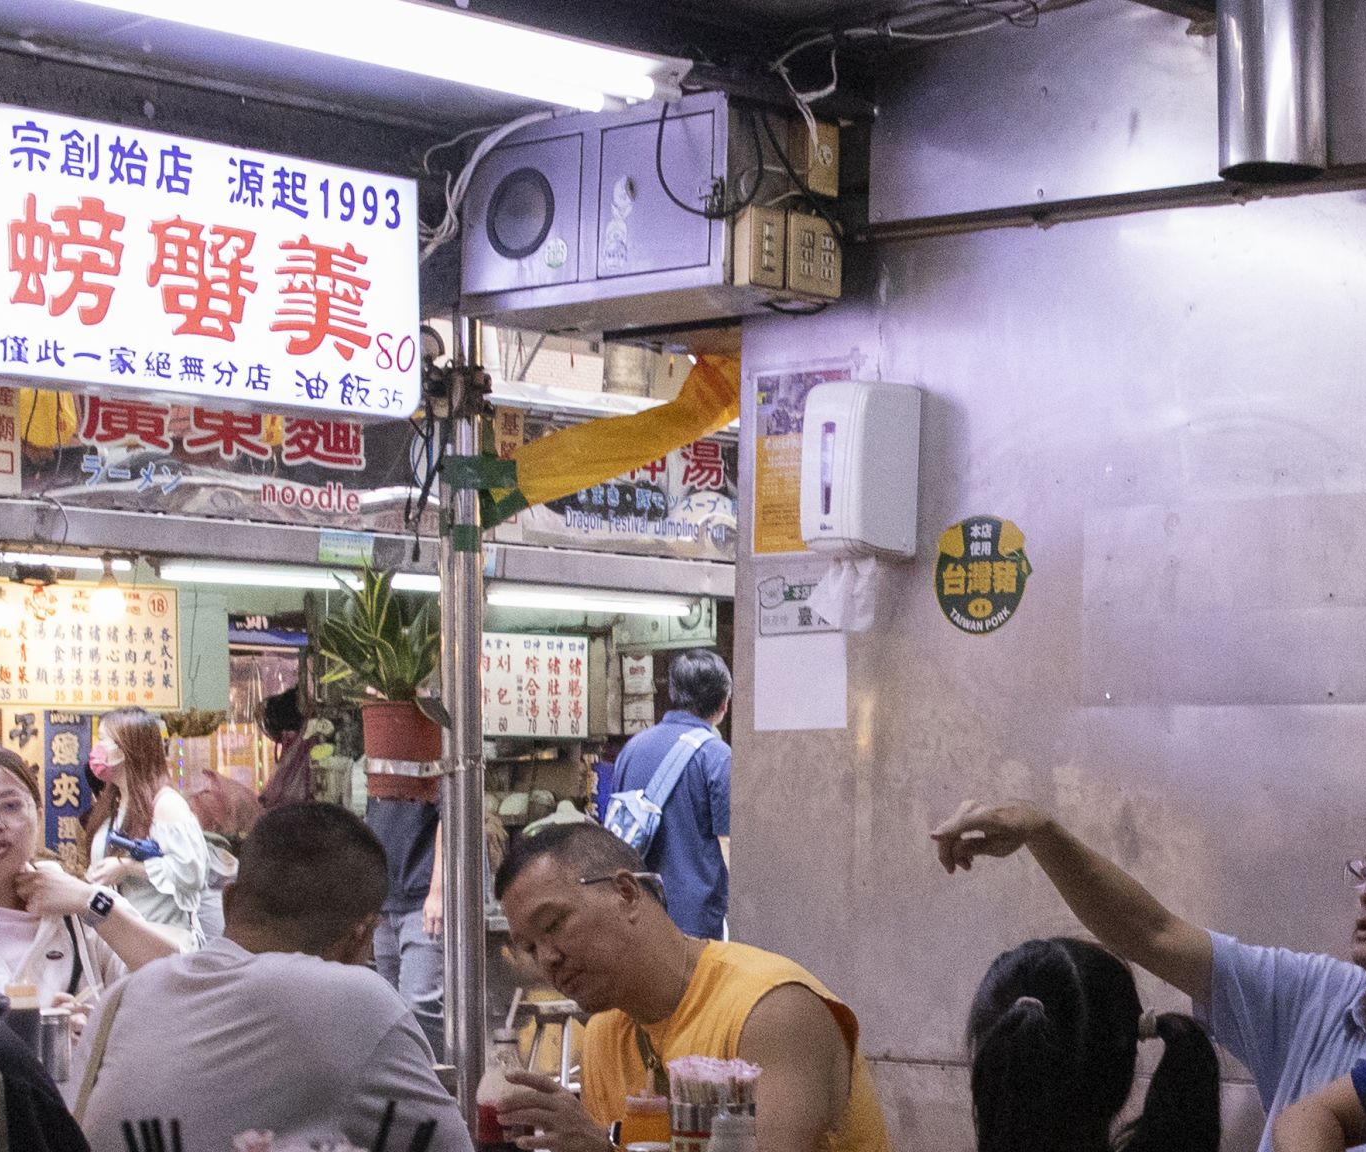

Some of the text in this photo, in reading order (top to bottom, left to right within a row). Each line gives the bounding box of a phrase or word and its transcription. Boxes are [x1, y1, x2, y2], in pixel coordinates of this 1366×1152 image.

[7, 193, 417, 374] 螃蟹羹 80
[0, 335, 272, 392] 僅此一家絕無分店
[82, 454, 184, 495] ラーメン
[261, 480, 361, 513] noodle
[565, 505, 603, 533] Dragon
[970, 523, 993, 539] 本店
[969, 541, 992, 556] 使用
[942, 561, 1018, 596] 台灣豬
[150, 598, 165, 613] 18
[949, 606, 1012, 632] TAIWAN PORK
